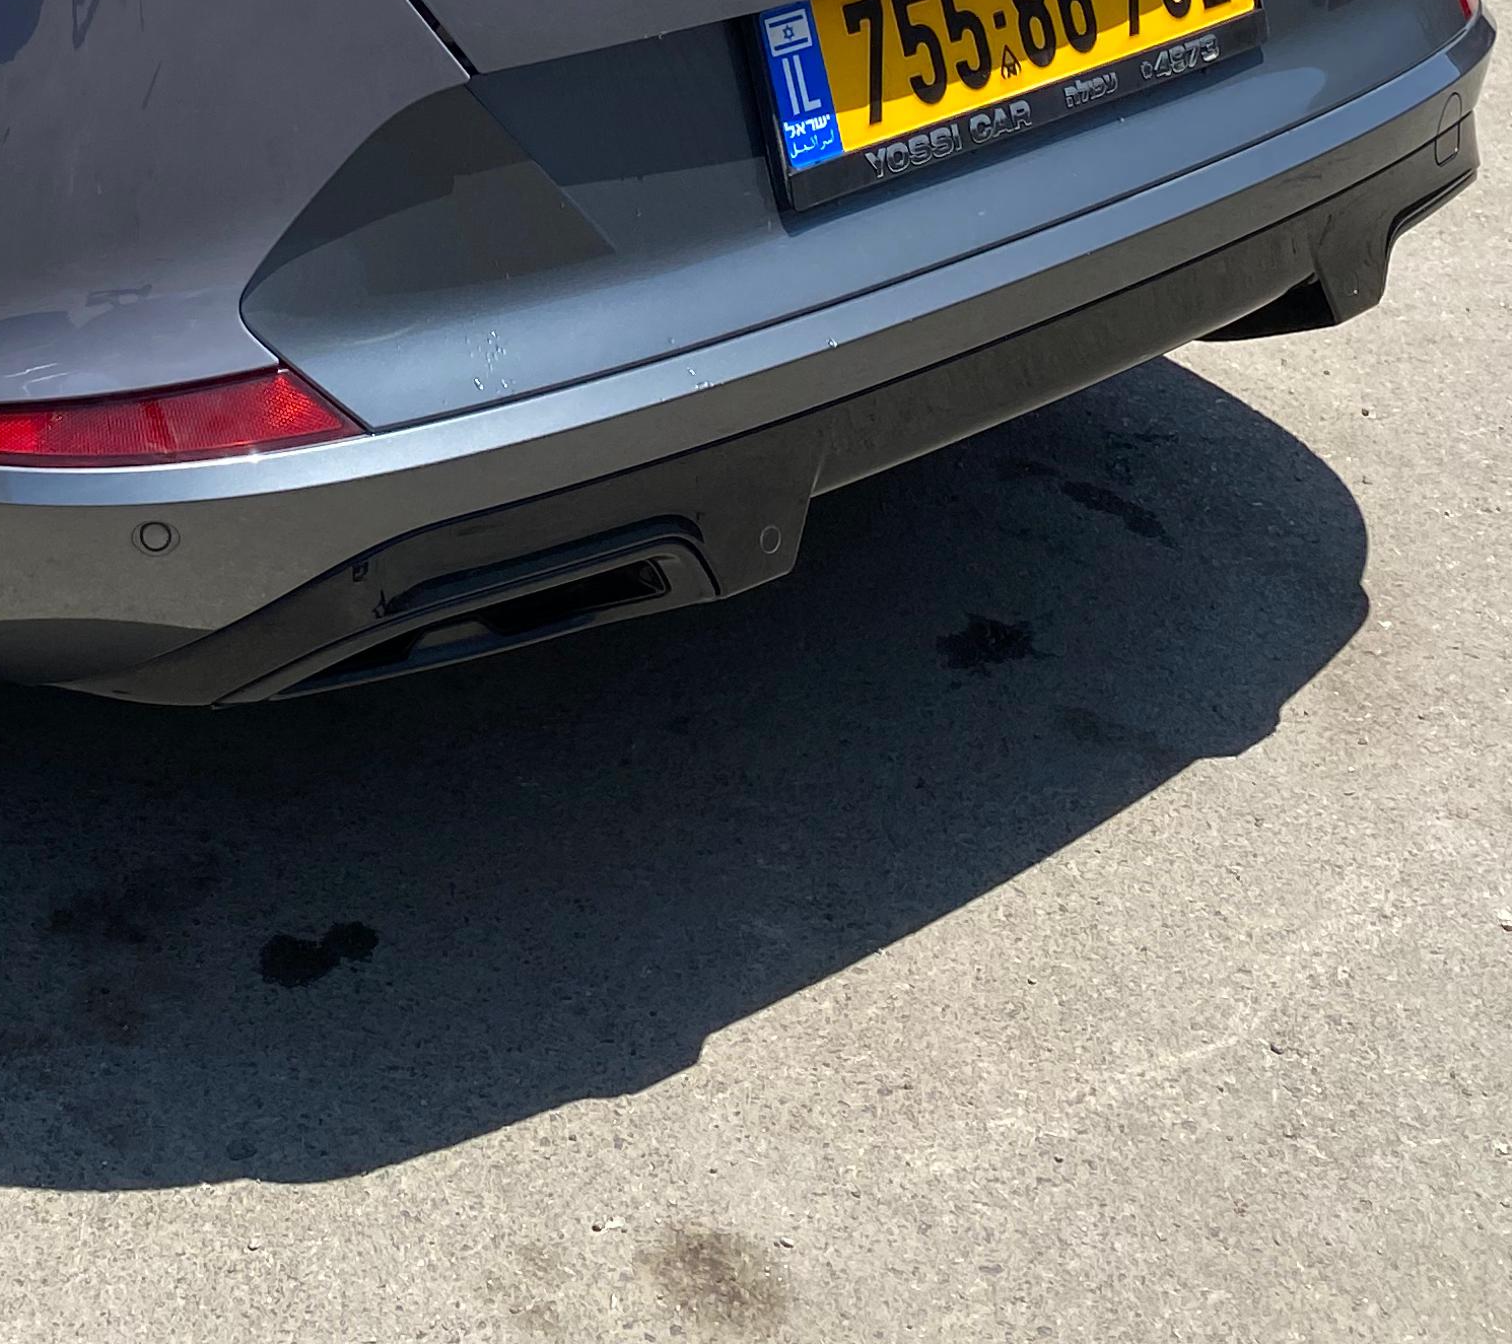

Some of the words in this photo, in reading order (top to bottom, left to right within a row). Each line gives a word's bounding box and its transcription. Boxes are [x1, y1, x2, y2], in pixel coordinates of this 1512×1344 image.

[782, 54, 822, 116] IL
[783, 113, 831, 139] ישראל
[865, 125, 964, 179] YOSSI
[969, 99, 1033, 144] CAR
